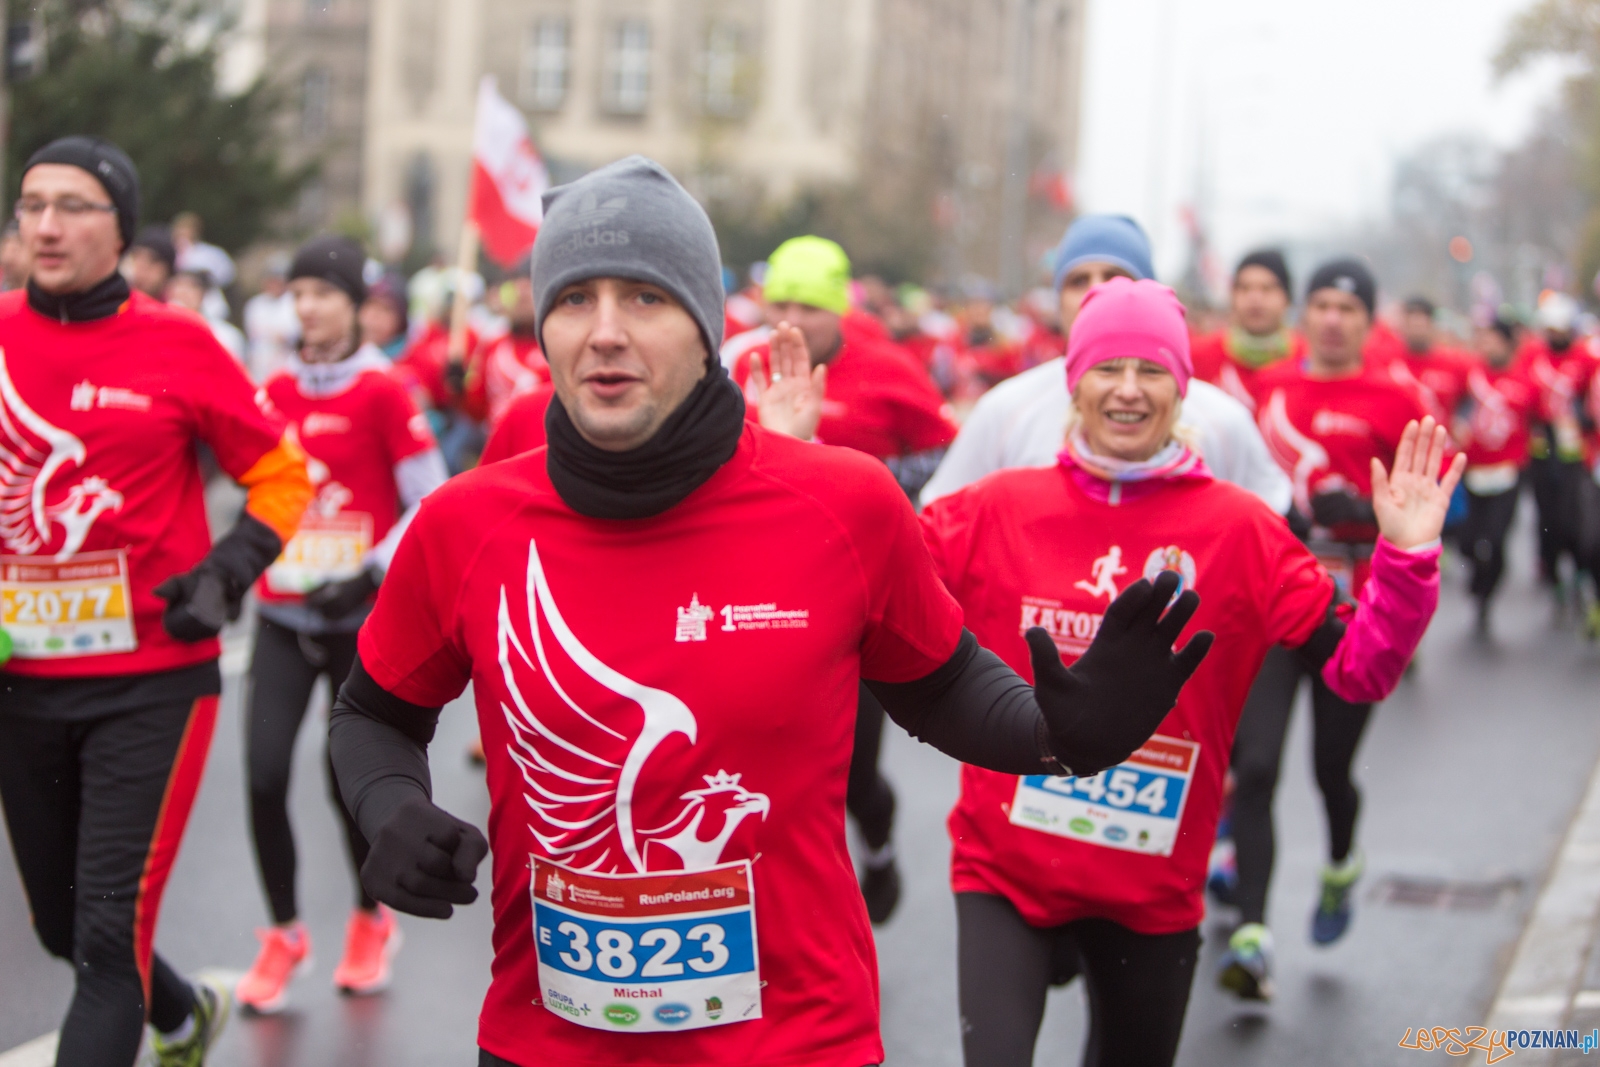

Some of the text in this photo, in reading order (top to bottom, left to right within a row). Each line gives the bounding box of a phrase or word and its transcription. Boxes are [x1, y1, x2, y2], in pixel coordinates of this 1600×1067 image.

[554, 227, 630, 258] adidas
[15, 586, 111, 622] 2077
[720, 604, 737, 631] 1
[639, 886, 735, 905] RunPoland.org
[539, 920, 730, 978] E 3823
[548, 988, 574, 1006] GRUPA
[613, 987, 663, 998] Michal
[549, 998, 580, 1017] LUXMED
